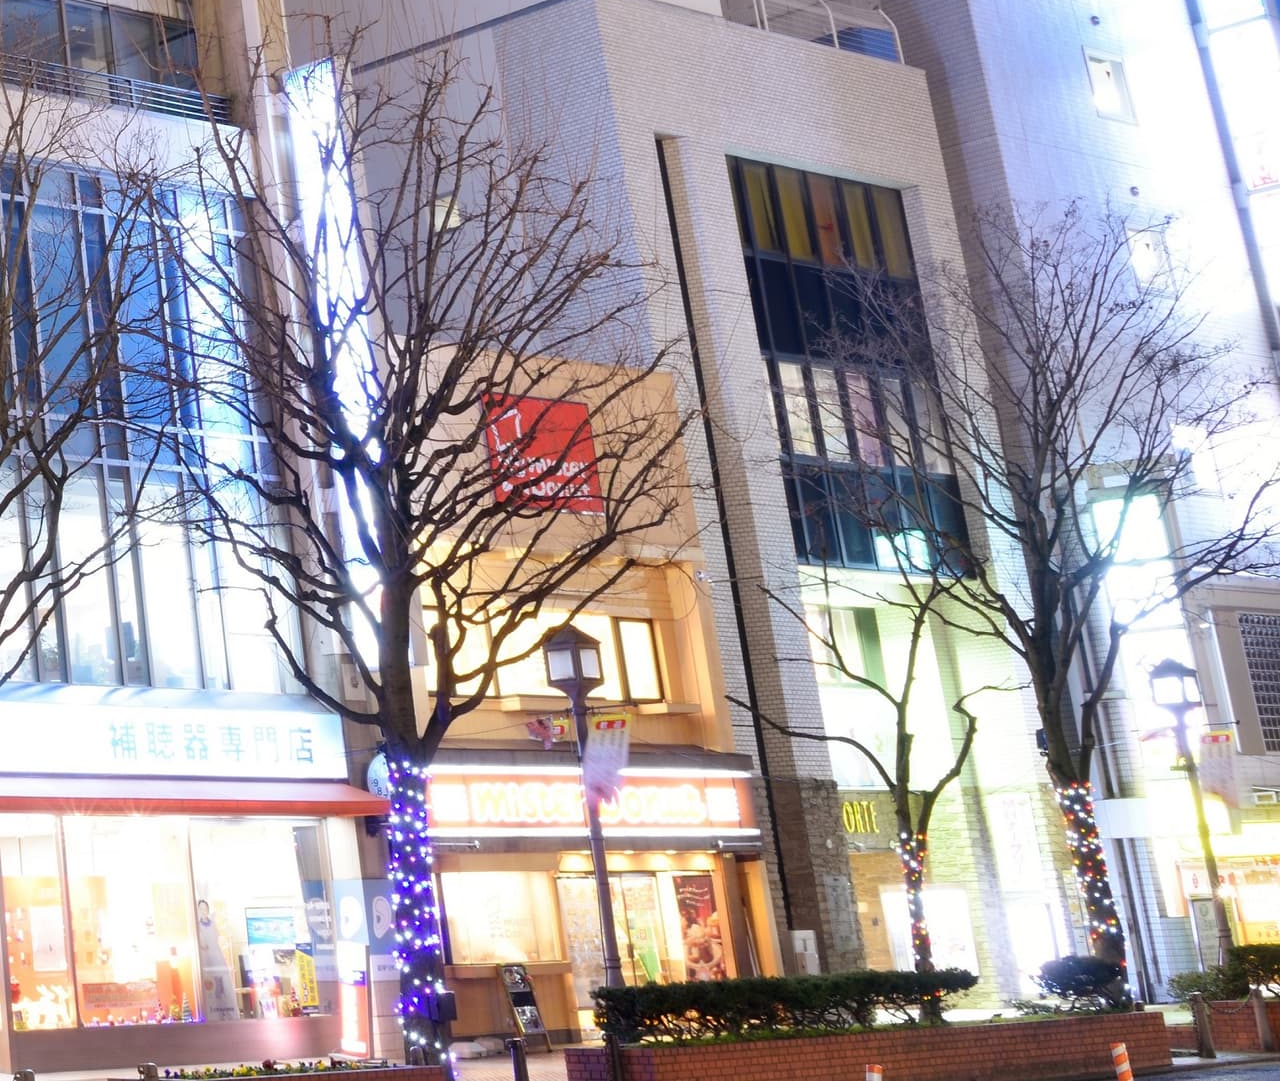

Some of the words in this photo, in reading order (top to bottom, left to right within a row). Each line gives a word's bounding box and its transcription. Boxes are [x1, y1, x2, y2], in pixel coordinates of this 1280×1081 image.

[108, 721, 314, 764] 補聴器専門店
